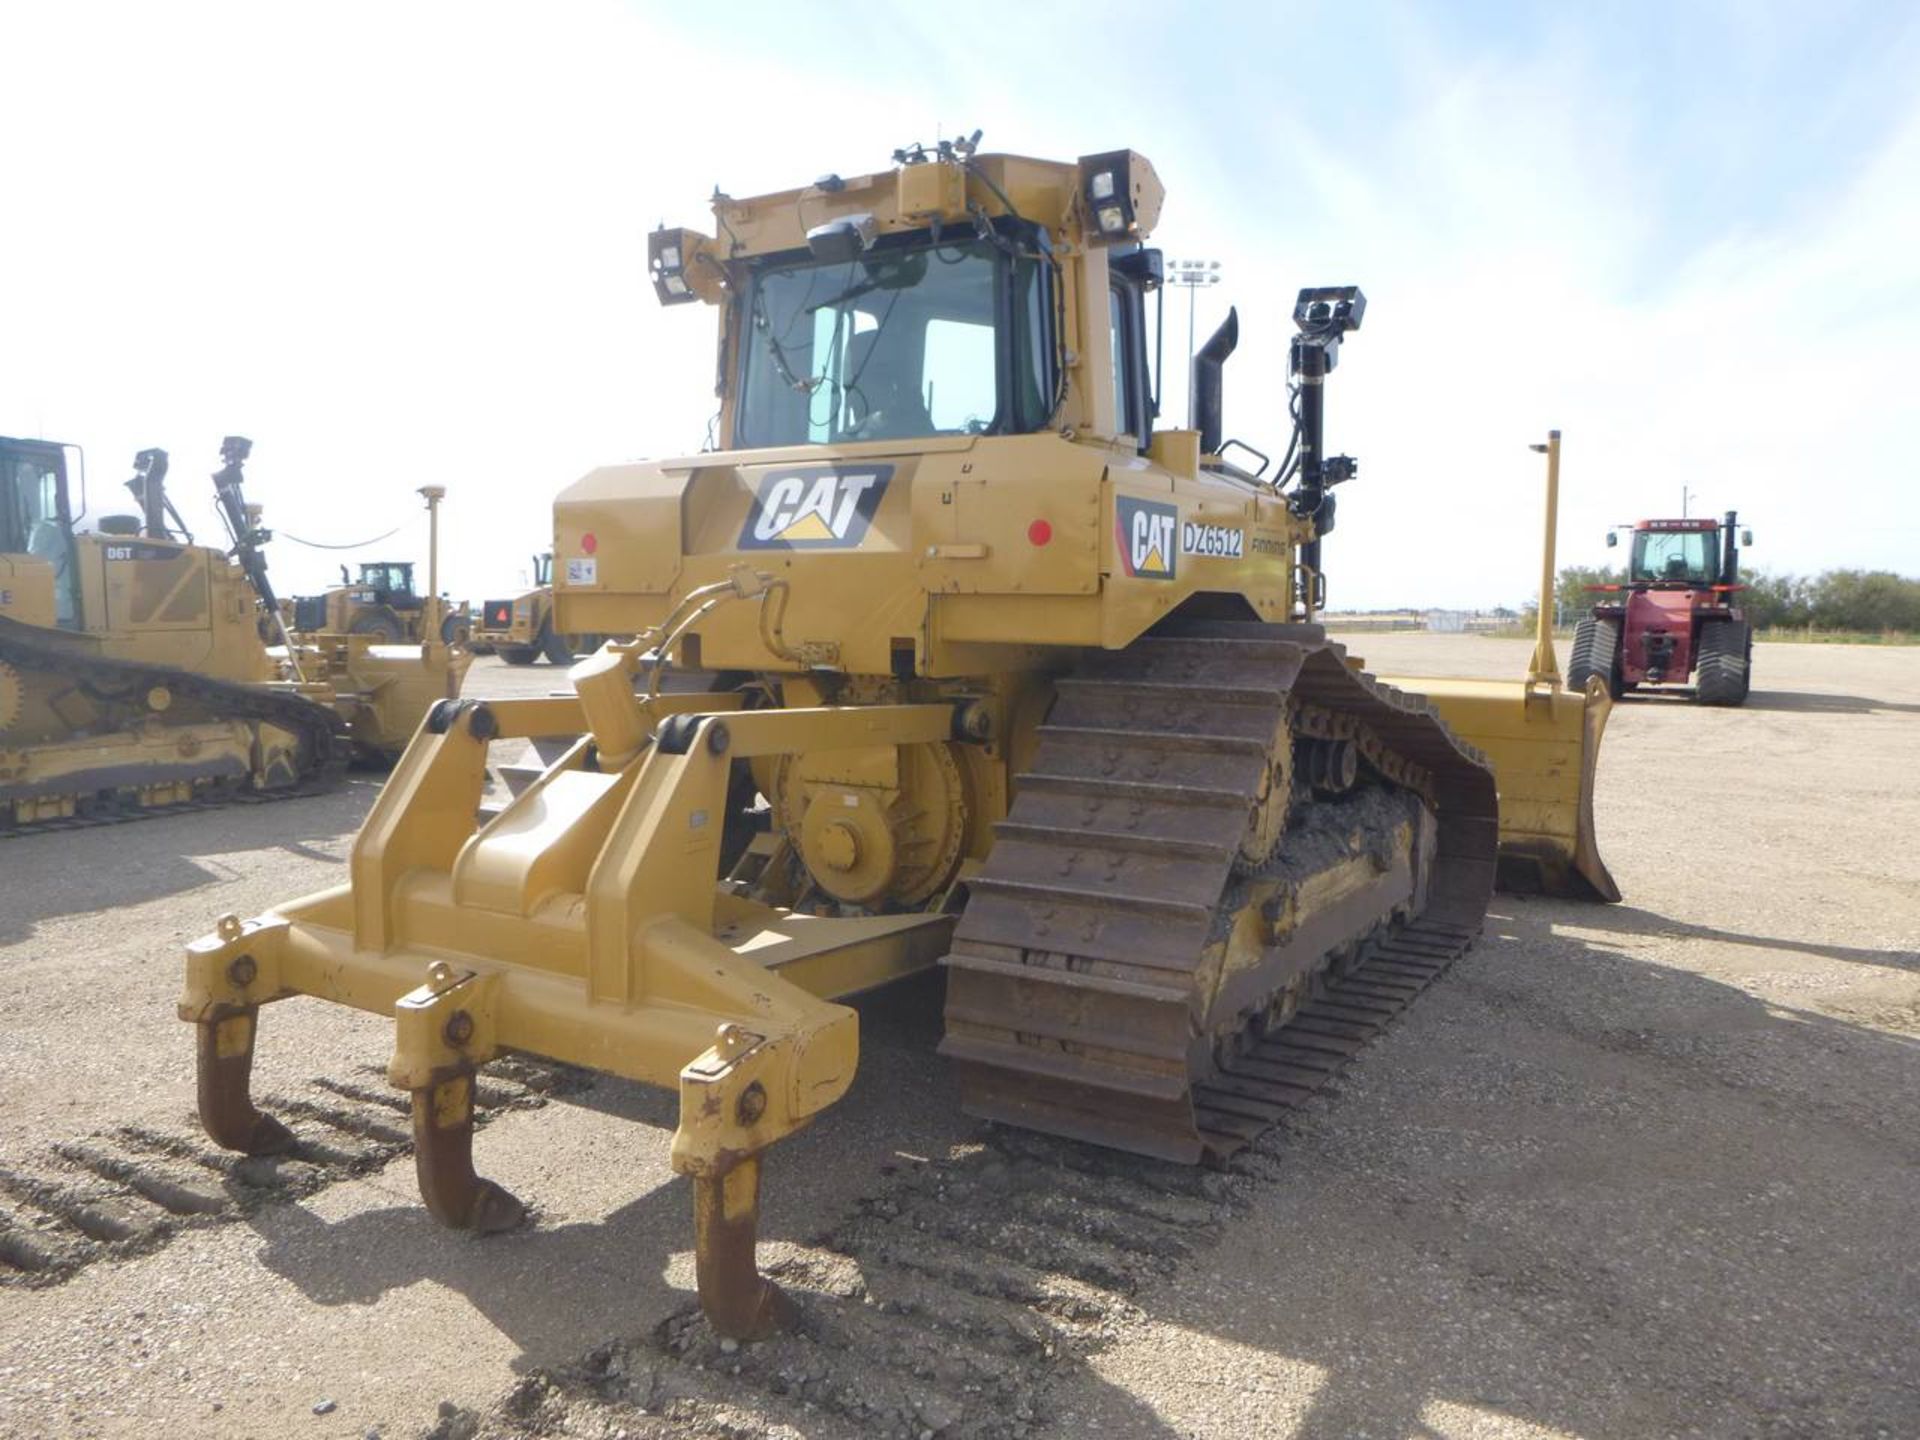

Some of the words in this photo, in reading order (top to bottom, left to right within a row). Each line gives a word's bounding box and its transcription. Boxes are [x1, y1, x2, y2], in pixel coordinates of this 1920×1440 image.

[754, 474, 877, 541] CAT
[107, 547, 132, 560] D6T
[1131, 509, 1175, 572] CAT
[1183, 522, 1241, 556] DZ6512
